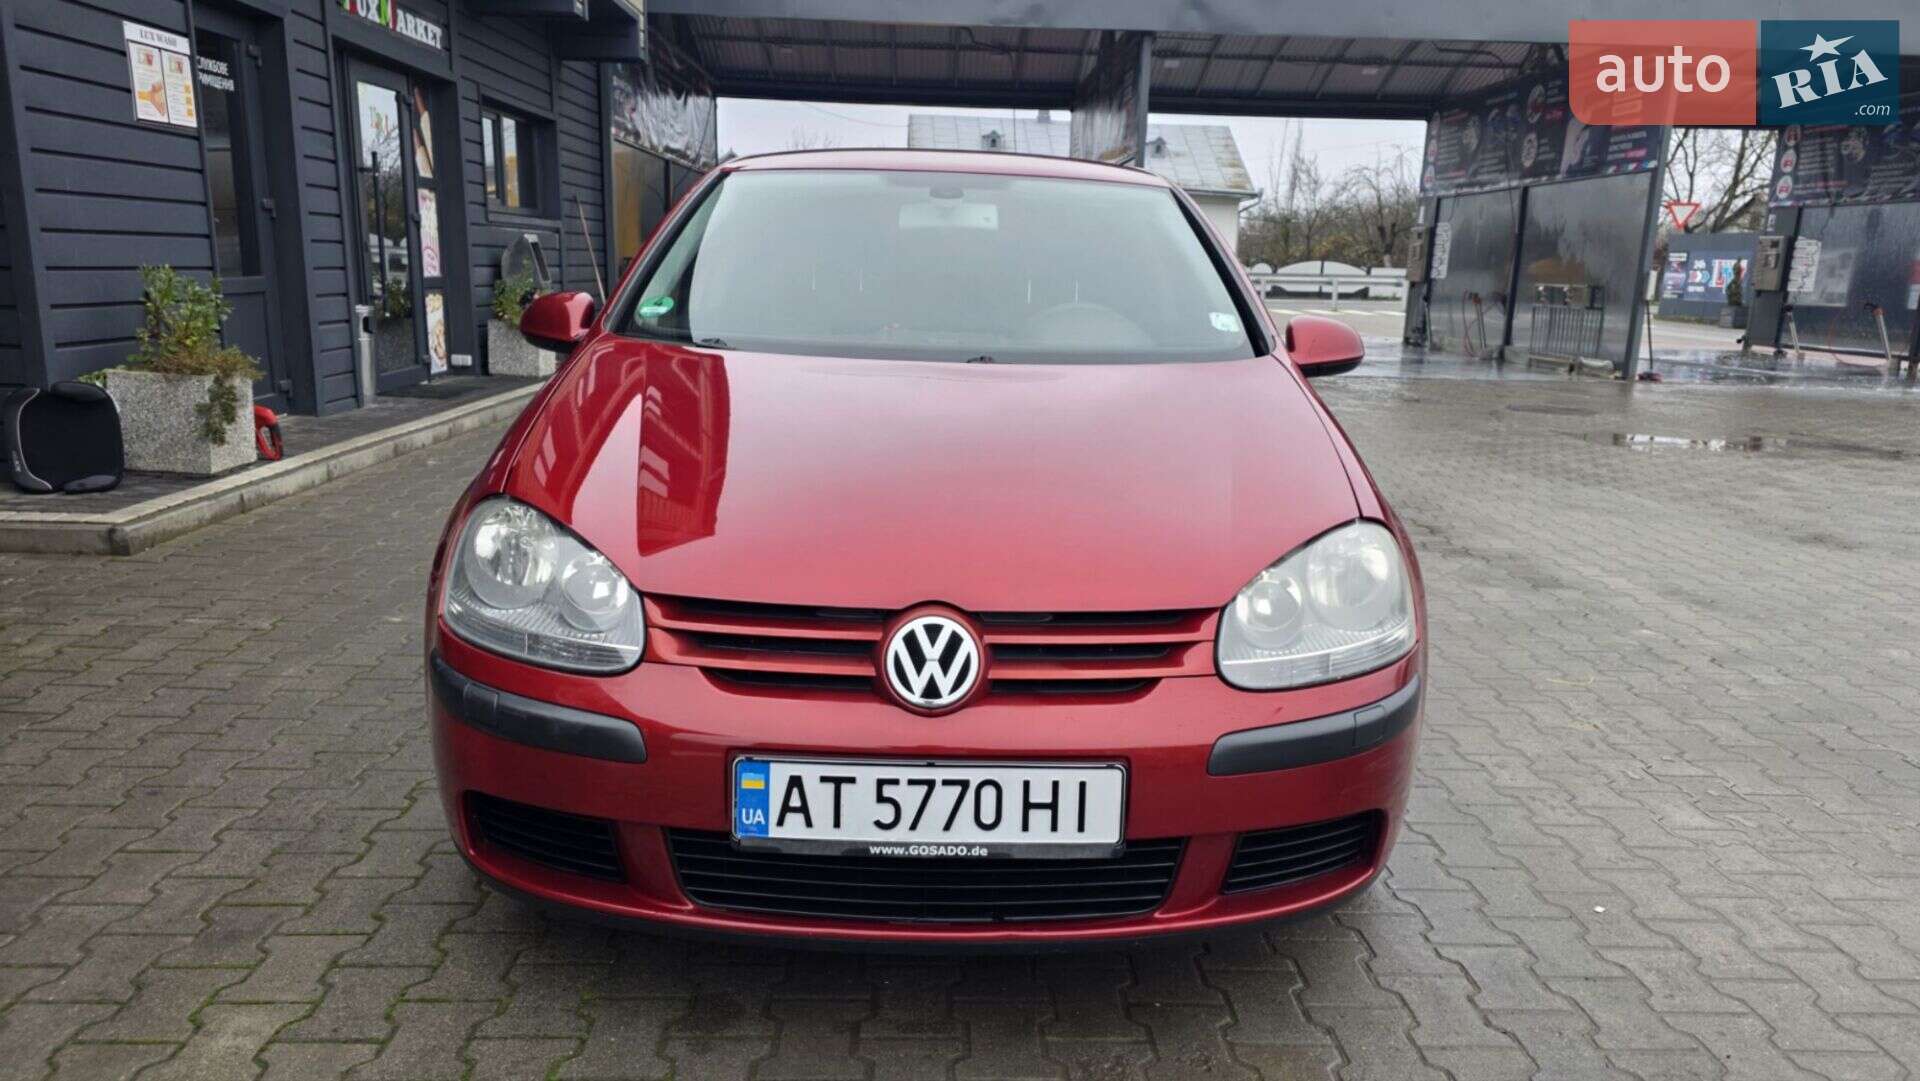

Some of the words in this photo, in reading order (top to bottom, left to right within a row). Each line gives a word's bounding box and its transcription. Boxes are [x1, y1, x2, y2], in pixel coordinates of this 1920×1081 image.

[339, 0, 381, 24] UX
[380, 0, 443, 50] MARKET
[742, 807, 766, 825] UA
[776, 774, 857, 829] AT
[873, 777, 1002, 832] 5770
[1021, 779, 1087, 833] HI
[869, 845, 989, 857] www.GOSADO.de
